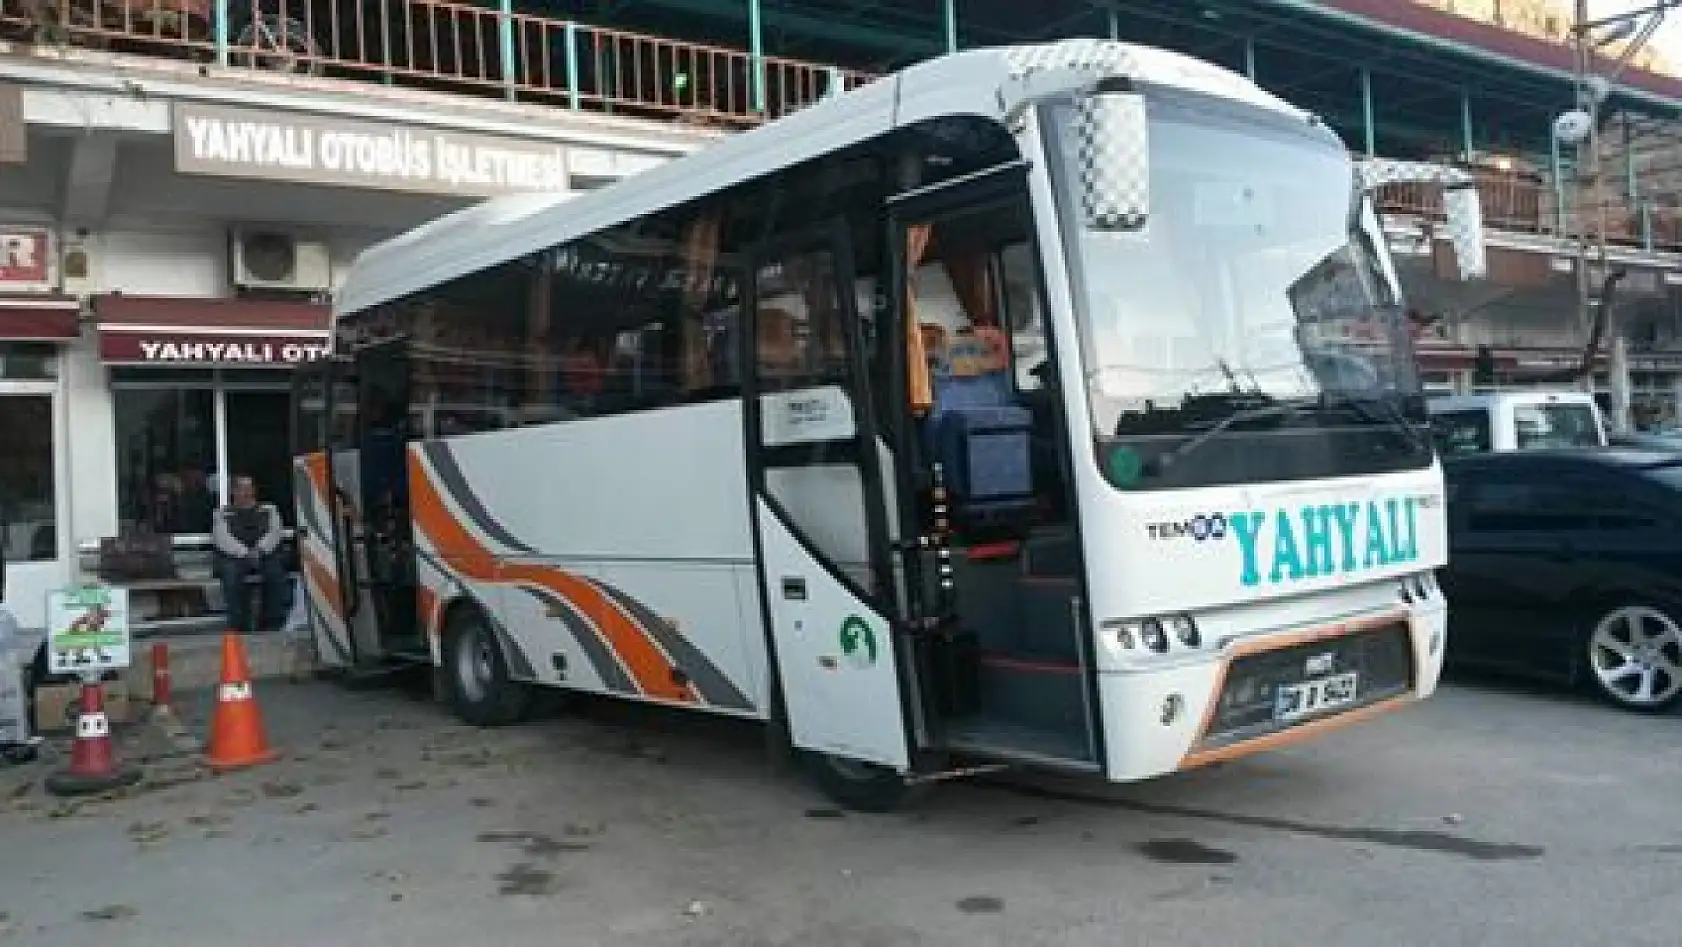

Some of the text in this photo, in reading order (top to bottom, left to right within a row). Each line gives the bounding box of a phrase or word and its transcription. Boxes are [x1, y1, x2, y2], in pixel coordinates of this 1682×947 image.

[185, 115, 313, 168] YAHYALI
[139, 341, 273, 362] YAHYALI
[1229, 497, 1418, 585] YAHYALI
